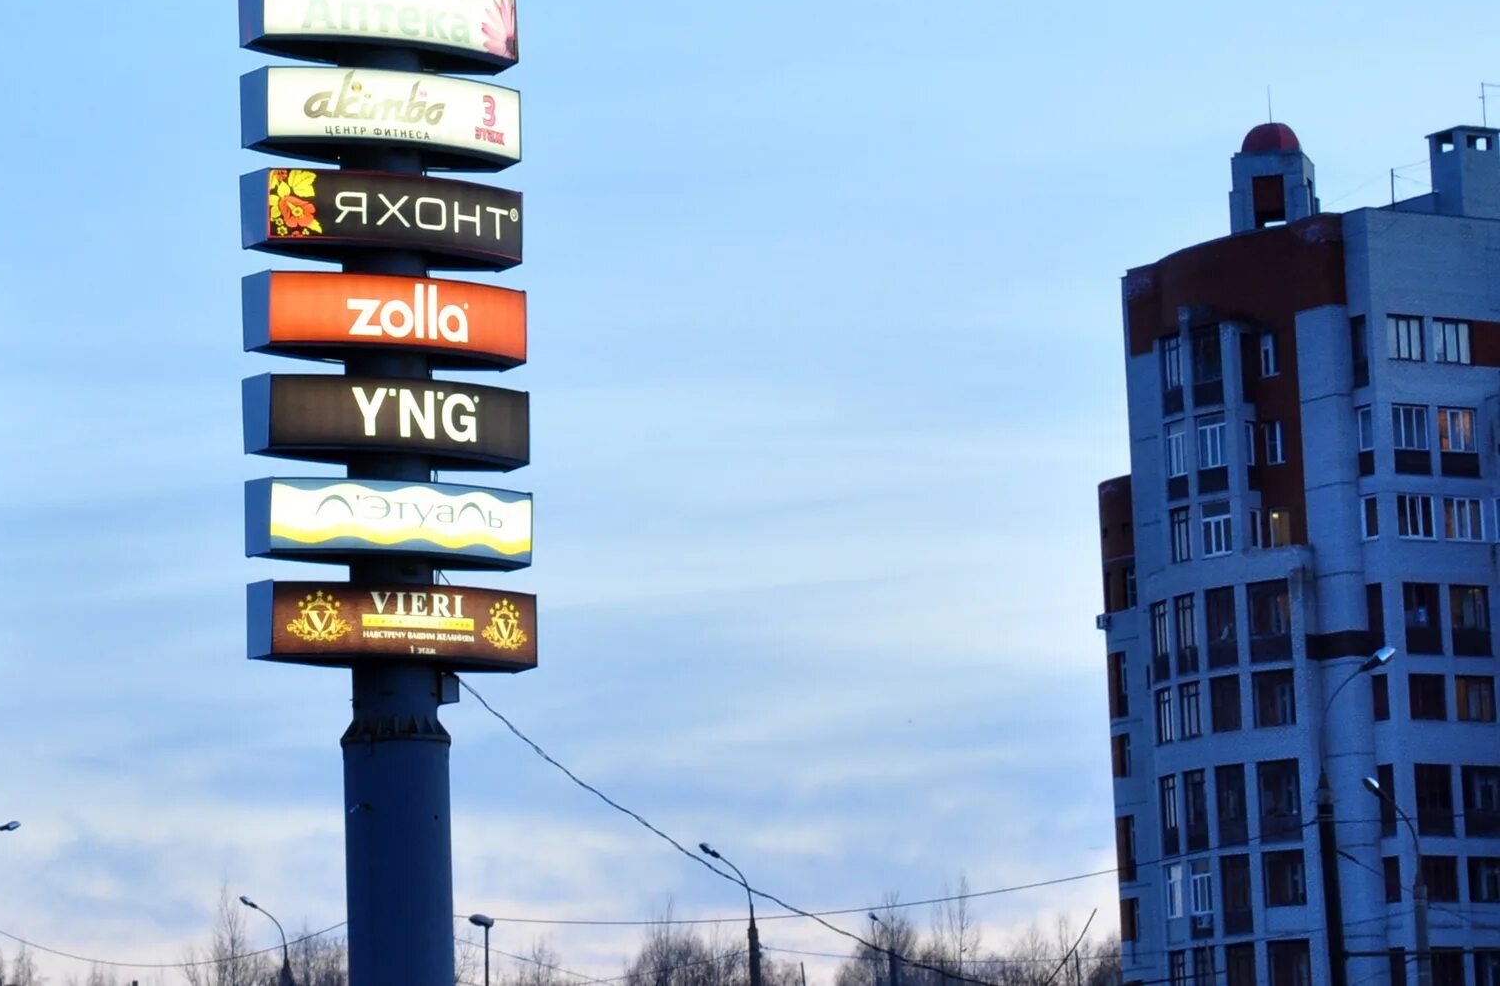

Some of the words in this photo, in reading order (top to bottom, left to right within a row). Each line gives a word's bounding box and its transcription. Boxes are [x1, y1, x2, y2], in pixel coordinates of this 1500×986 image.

[303, 69, 446, 126] akimbo
[482, 95, 496, 127] 3
[325, 125, 367, 136] ЦЕНТР
[373, 127, 431, 141] ФИТНЕСА
[347, 283, 469, 343] zolla
[370, 591, 465, 618] VIERI
